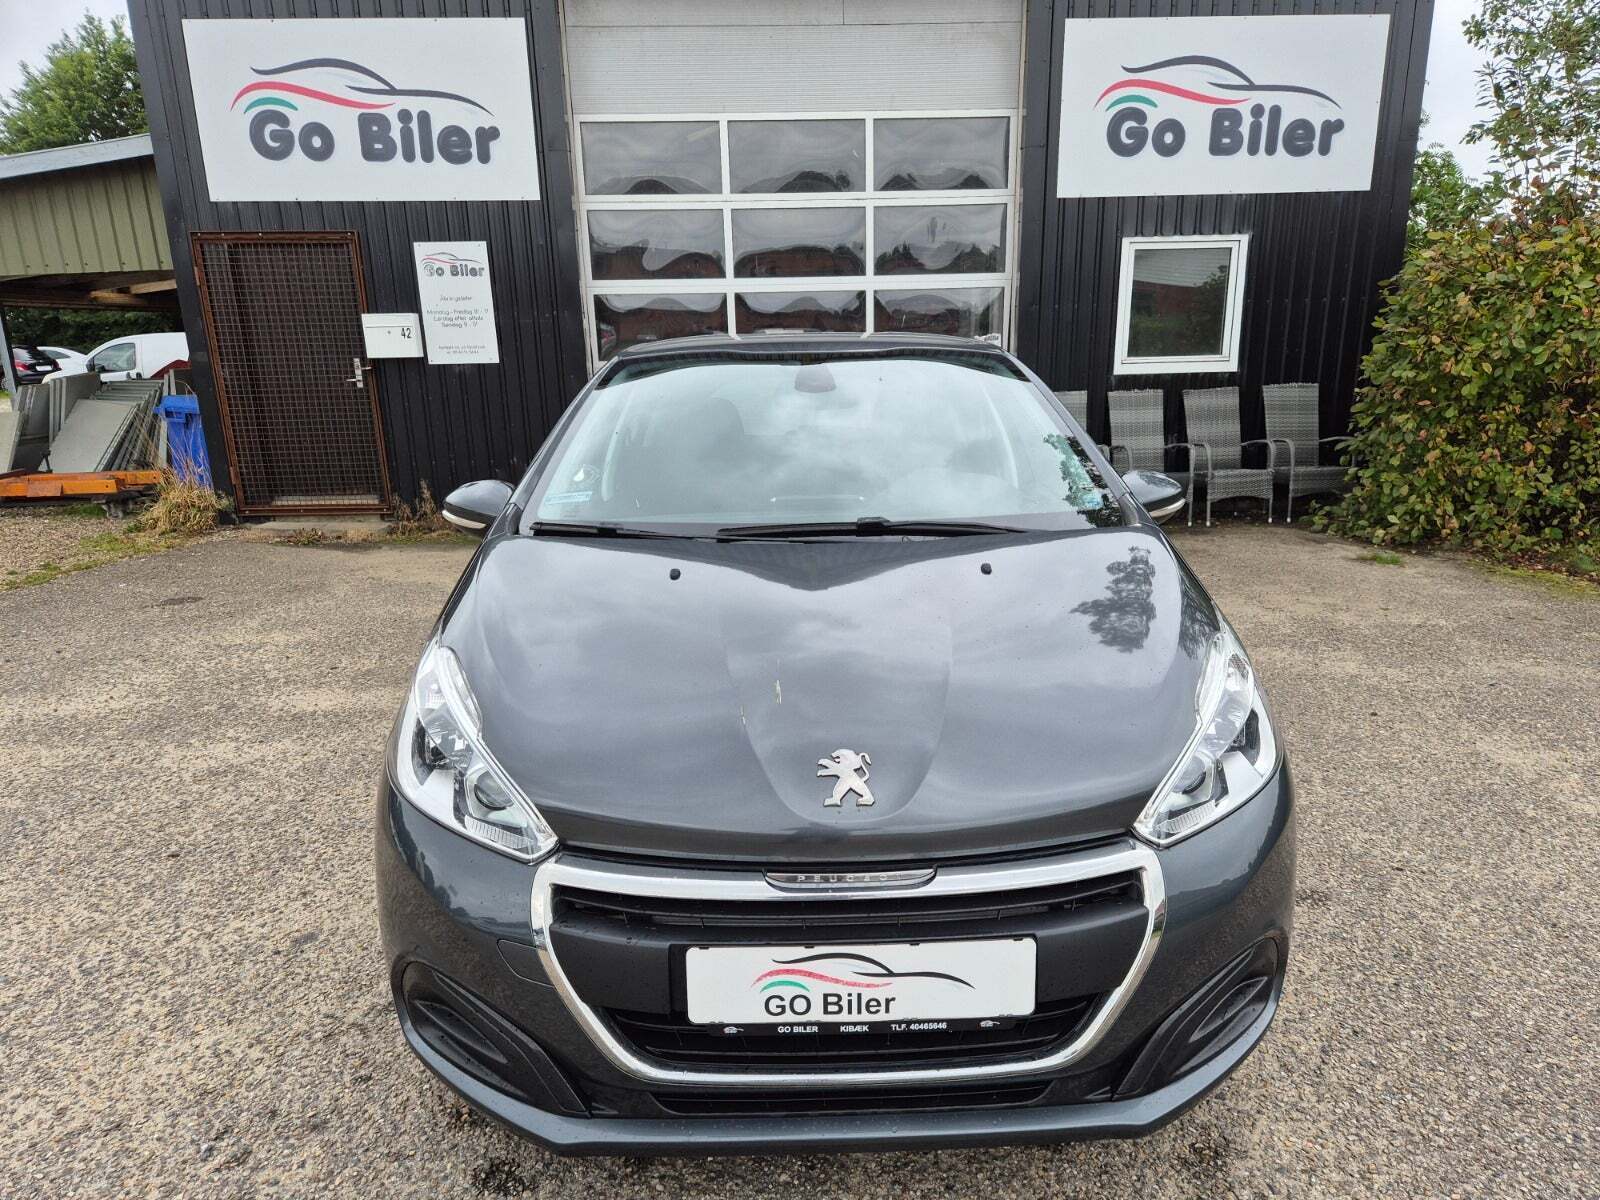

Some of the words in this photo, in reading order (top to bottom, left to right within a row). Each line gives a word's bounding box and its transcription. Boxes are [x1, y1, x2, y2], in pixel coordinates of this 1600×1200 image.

[249, 109, 335, 161] Go
[358, 109, 500, 165] Biler
[1107, 107, 1185, 157] Go
[1209, 104, 1344, 157] Biler
[424, 264, 445, 277] Go
[450, 263, 485, 277] Biler
[401, 327, 412, 339] 42
[765, 994, 811, 1016] GO
[823, 993, 895, 1015] Biler
[777, 1025, 791, 1034] GO
[793, 1025, 818, 1033] BILER
[840, 1024, 869, 1033] KIBÆK
[891, 1023, 908, 1031] TLF.
